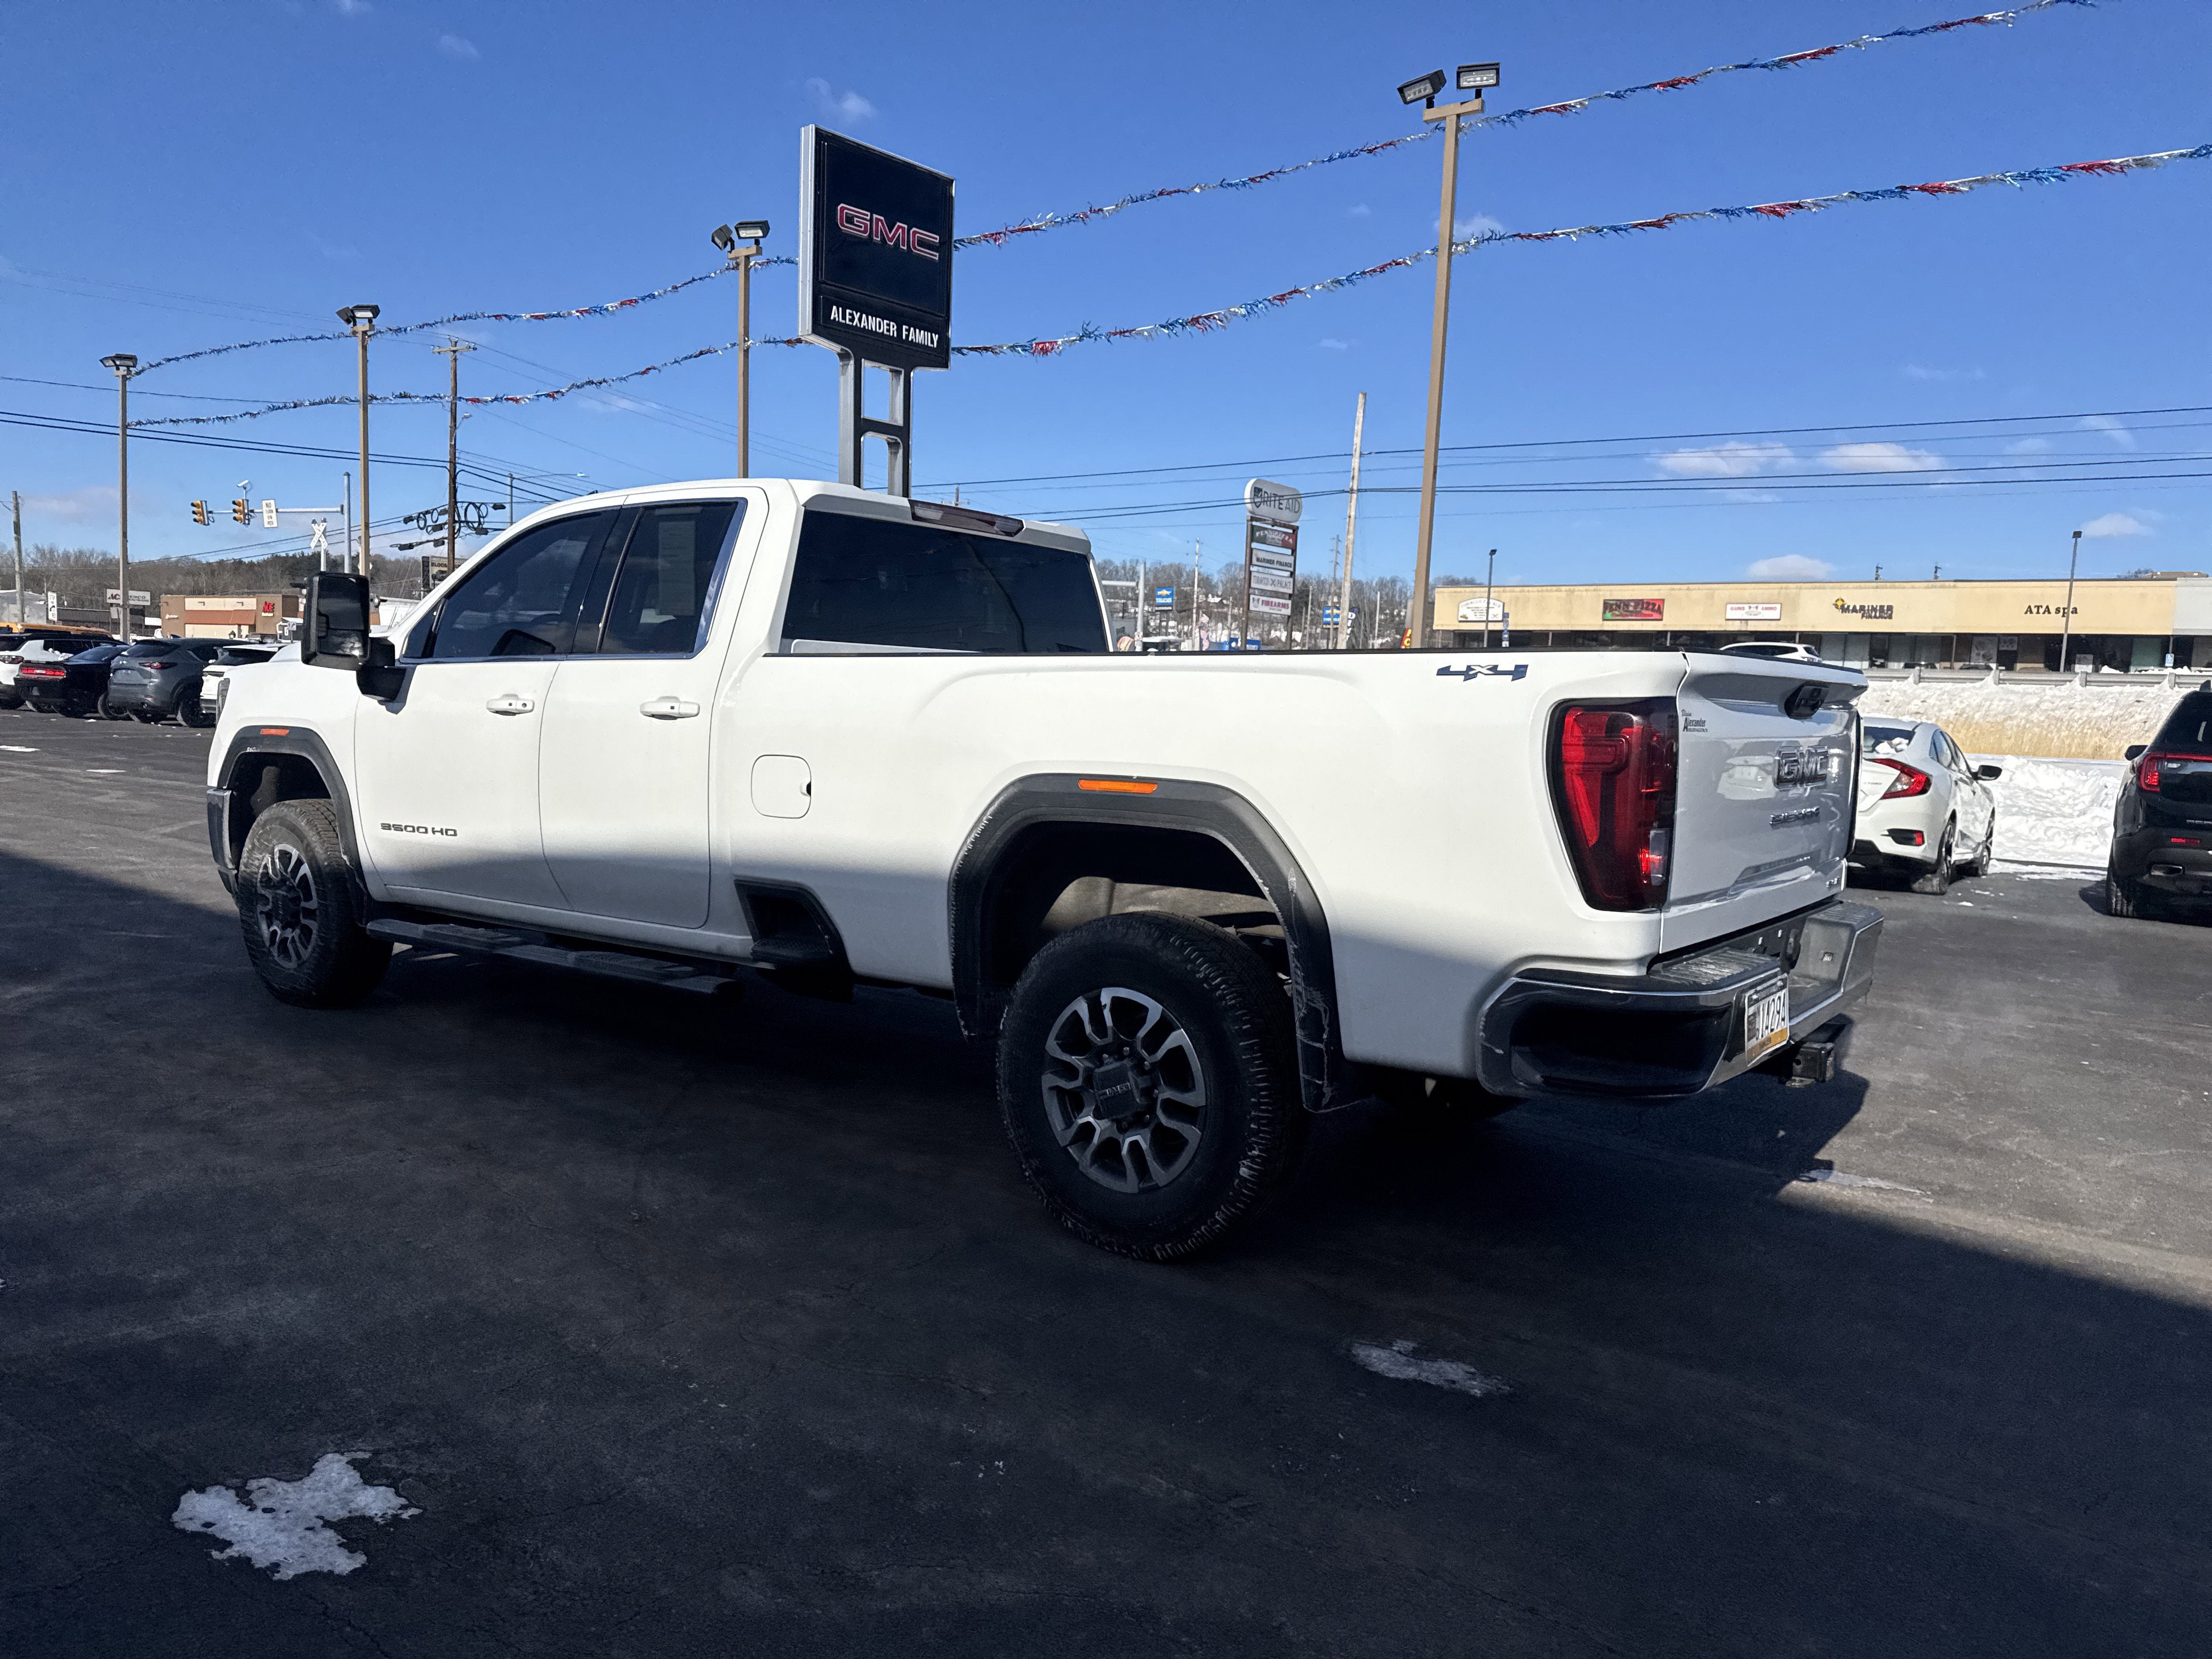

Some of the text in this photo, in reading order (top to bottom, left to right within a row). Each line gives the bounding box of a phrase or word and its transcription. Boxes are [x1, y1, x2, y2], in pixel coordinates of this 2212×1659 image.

[838, 203, 940, 260] GMC
[831, 305, 939, 348] ALEXANDER FAMILY
[1263, 491, 1300, 514] RITE AID
[1256, 556, 1275, 565] MARINER
[1261, 599, 1290, 610] FIREARMS
[1841, 604, 1894, 614] MARINER
[2024, 605, 2078, 618] ATA spa
[1773, 746, 1830, 789] GMC
[380, 822, 458, 837] 3500 HD
